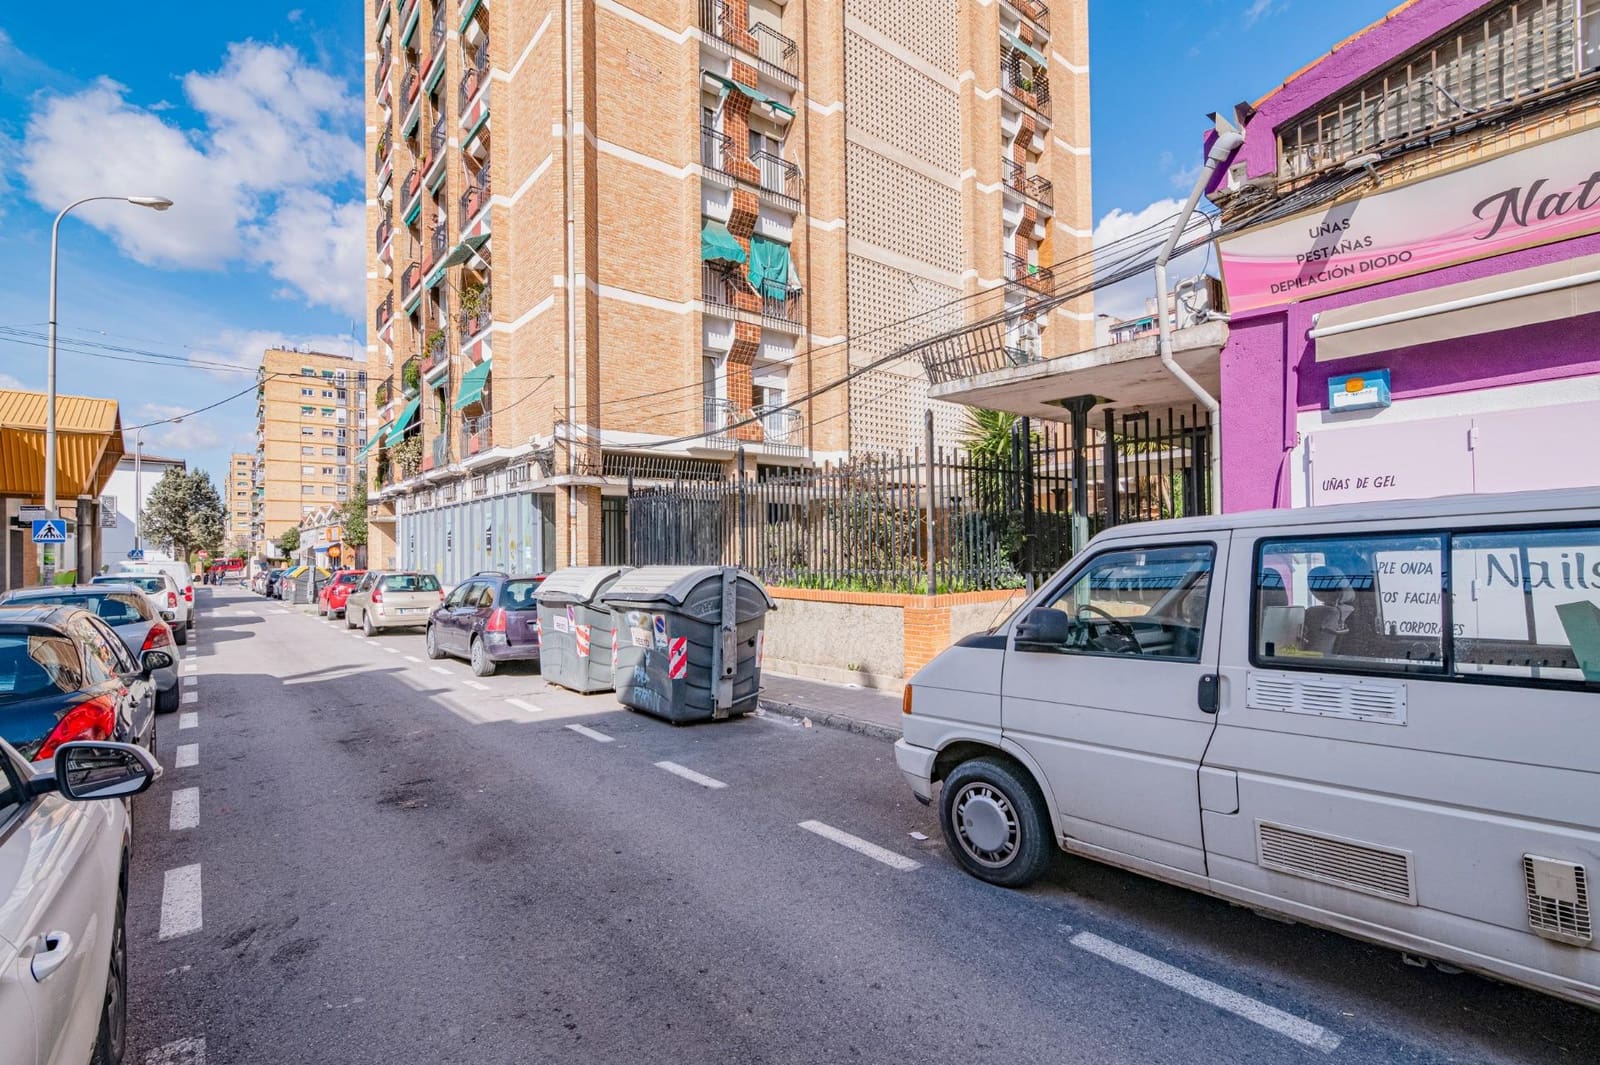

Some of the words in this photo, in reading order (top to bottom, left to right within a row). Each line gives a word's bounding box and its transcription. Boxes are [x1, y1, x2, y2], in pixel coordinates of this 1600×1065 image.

[1308, 218, 1351, 239] UÑAS
[1296, 235, 1373, 265] PESTAÑAS
[1270, 264, 1355, 294] DEPILACIÓN
[1359, 250, 1413, 273] DIODO
[1322, 477, 1350, 491] UÑAS
[1356, 477, 1370, 489] DE
[1373, 475, 1396, 488] GEL
[1400, 562, 1433, 575] ONDA
